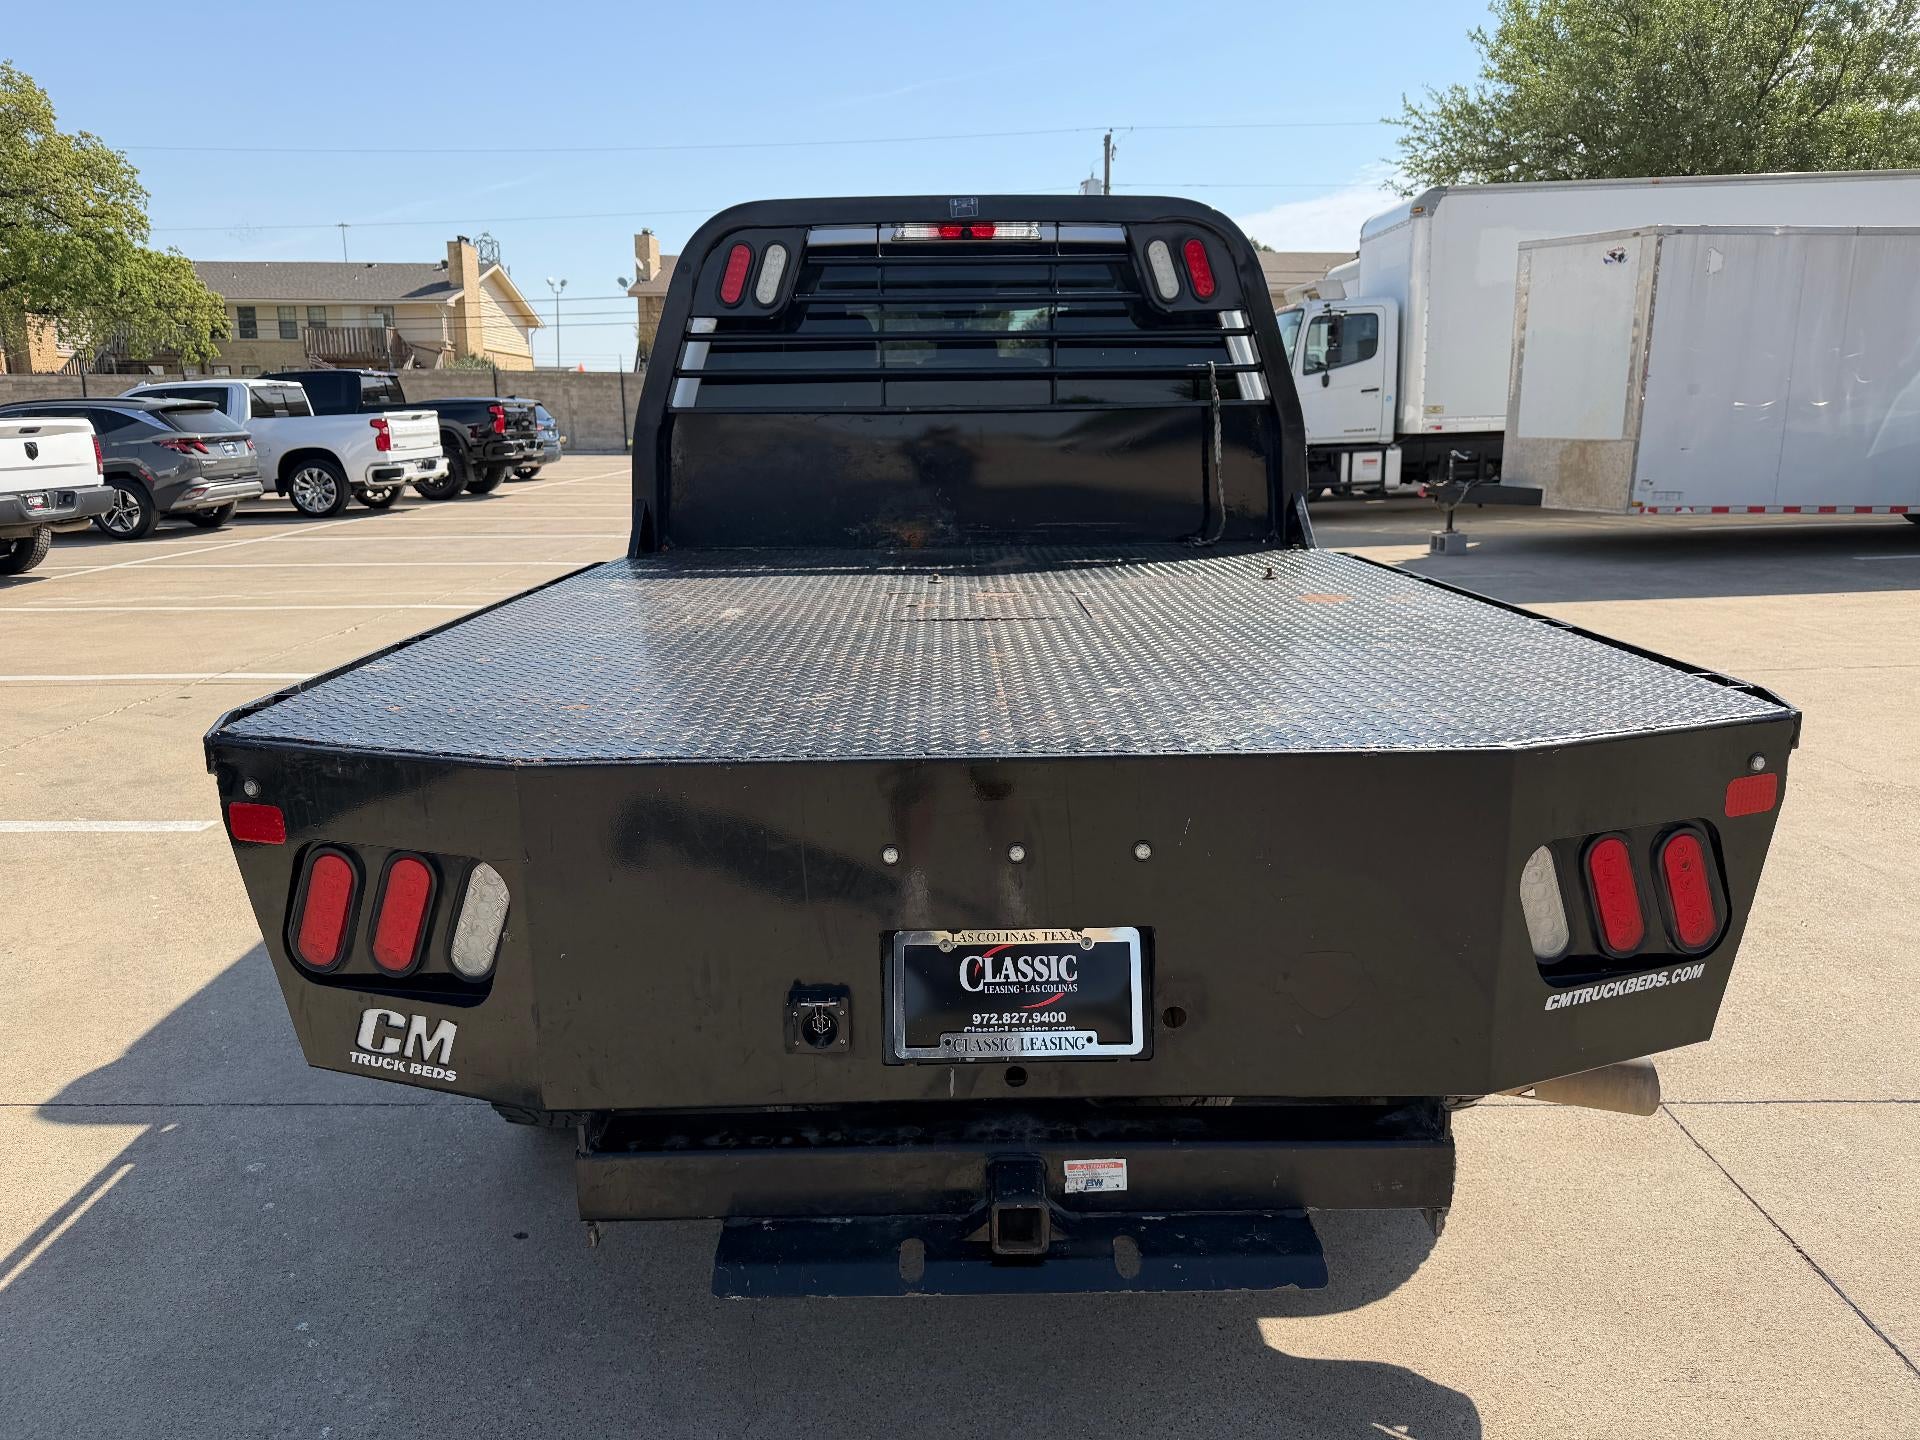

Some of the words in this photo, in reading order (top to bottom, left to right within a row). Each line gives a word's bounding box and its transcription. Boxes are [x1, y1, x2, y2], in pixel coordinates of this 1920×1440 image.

[951, 933, 974, 943] LAS
[1042, 930, 1083, 941] TEXAS
[959, 955, 1078, 992] CLASSIC
[984, 985, 1020, 994] LEASING
[1025, 984, 1040, 993] LAS
[1041, 983, 1078, 993] COLINAS
[1544, 963, 1705, 1011] CMTRUCKBEDS.COM
[972, 1011, 1067, 1025] 972.827.9400
[357, 1008, 458, 1065] CM
[953, 1037, 1015, 1052] CLASSIC
[1020, 1036, 1086, 1051] LEASING
[350, 1051, 406, 1072] TRUCK
[409, 1062, 457, 1081] BEDS
